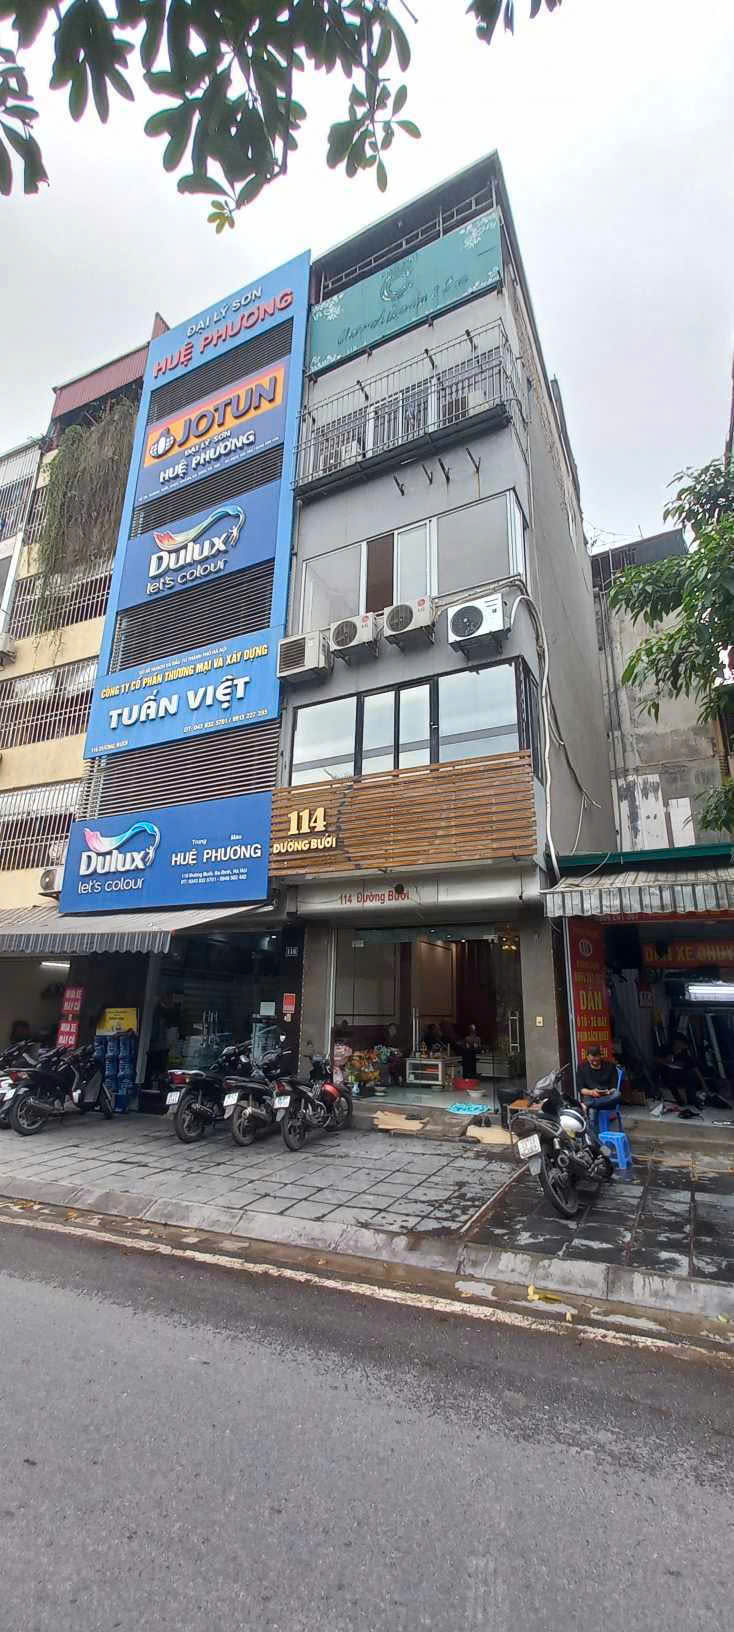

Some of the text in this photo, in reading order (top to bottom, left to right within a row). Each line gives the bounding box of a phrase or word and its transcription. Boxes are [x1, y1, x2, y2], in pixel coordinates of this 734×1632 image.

[153, 338, 194, 379] HUỆ
[199, 288, 294, 354] PHƯƠNG
[177, 376, 278, 448] JOTUN
[159, 458, 188, 483] HUỆ
[191, 430, 256, 471] PHƯƠNG
[148, 531, 228, 579] Dulux
[145, 558, 228, 595] let's colour
[100, 686, 120, 700] CÔNG
[120, 683, 130, 695] TY
[163, 666, 194, 682] THƯƠNG
[195, 662, 212, 676] MẠI
[225, 650, 242, 667] XÂY
[243, 644, 268, 664] DỰNG
[109, 674, 251, 730] TUẤN VIỆT
[287, 807, 327, 836] 114
[79, 848, 146, 876] Dulux
[171, 842, 262, 867] HUỆ PHƯƠNG
[78, 876, 145, 895] let's colour
[340, 894, 353, 905] 114
